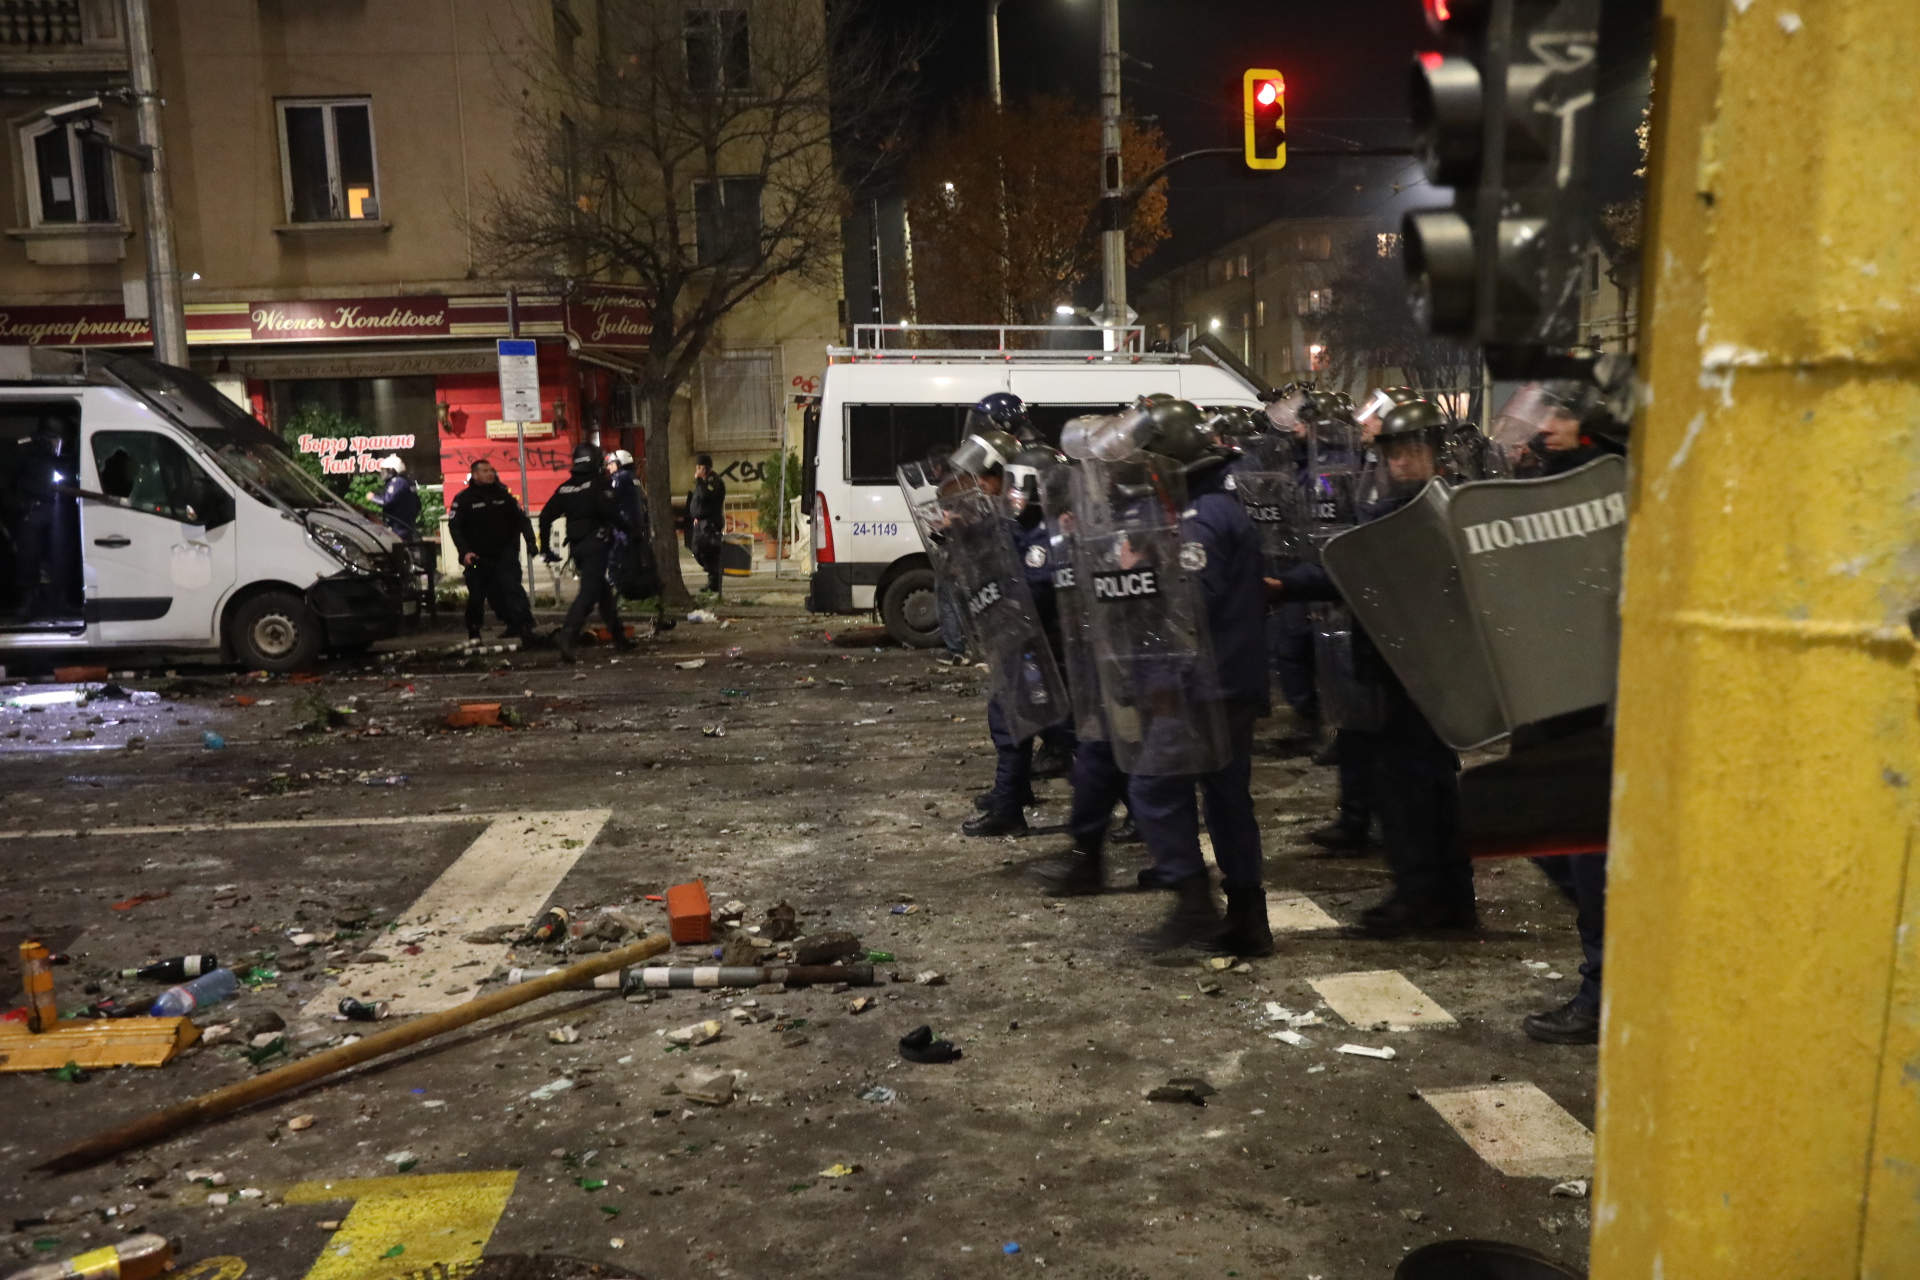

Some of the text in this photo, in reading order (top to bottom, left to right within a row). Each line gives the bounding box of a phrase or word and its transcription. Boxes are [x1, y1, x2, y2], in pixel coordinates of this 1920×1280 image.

[252, 306, 444, 331] Wiener Konditorei
[298, 434, 415, 457] Бързо хранене
[321, 455, 356, 474] Fast
[853, 522, 898, 536] 24-1149
[1462, 491, 1626, 555] ПОЛИЦИЯ
[1094, 572, 1157, 597] POLICE
